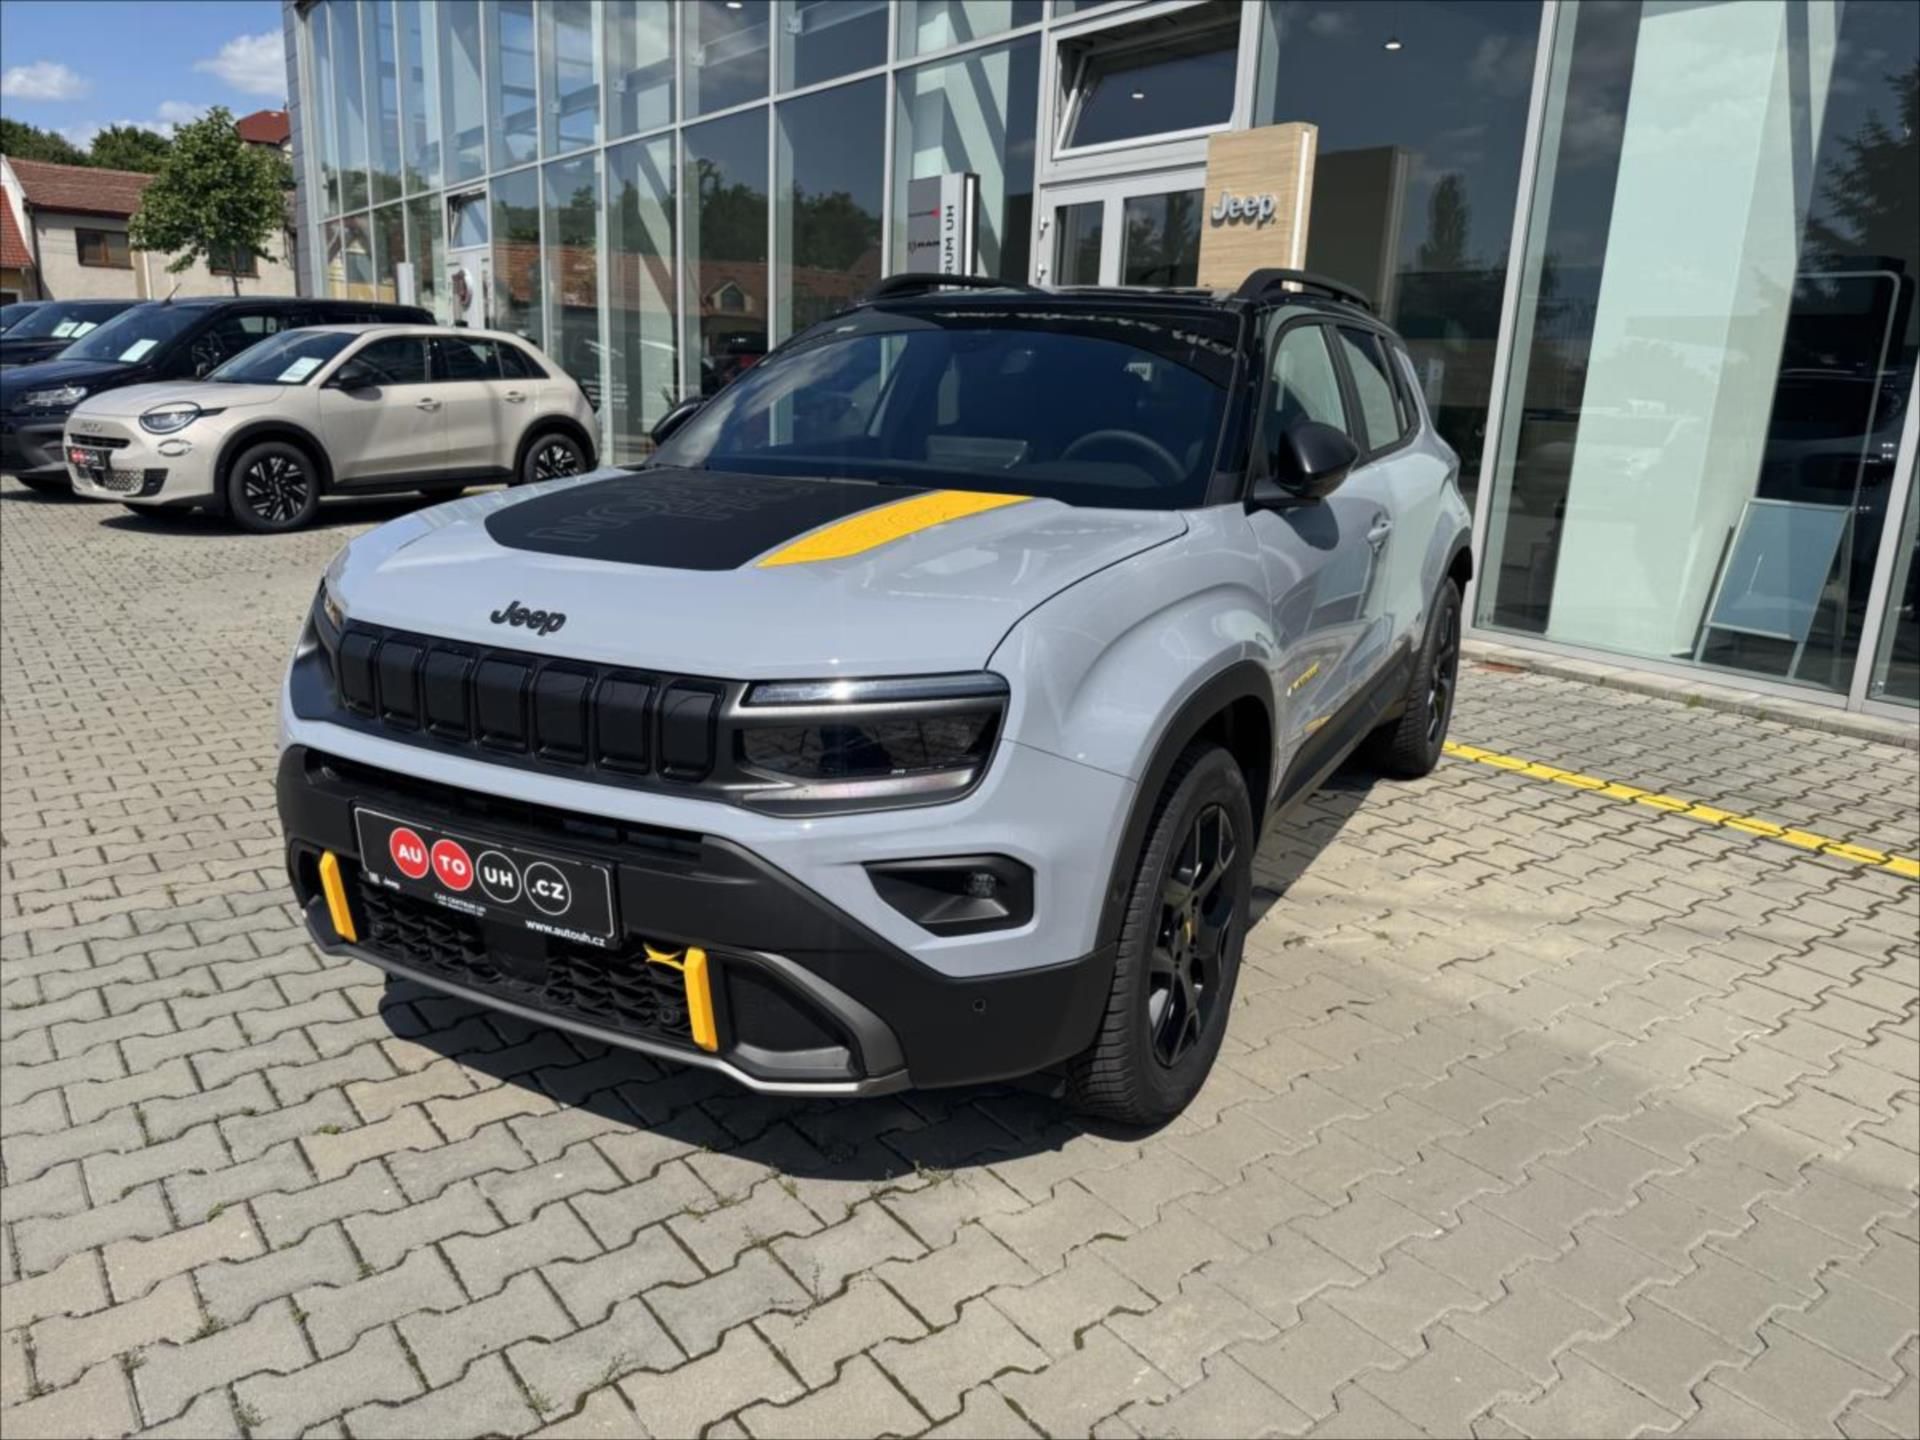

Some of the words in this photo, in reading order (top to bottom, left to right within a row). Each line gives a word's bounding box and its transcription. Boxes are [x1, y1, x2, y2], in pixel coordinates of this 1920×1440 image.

[1210, 191, 1275, 223] Jeep
[490, 600, 567, 637] Jeep
[525, 919, 606, 947] www.autouh.cz
